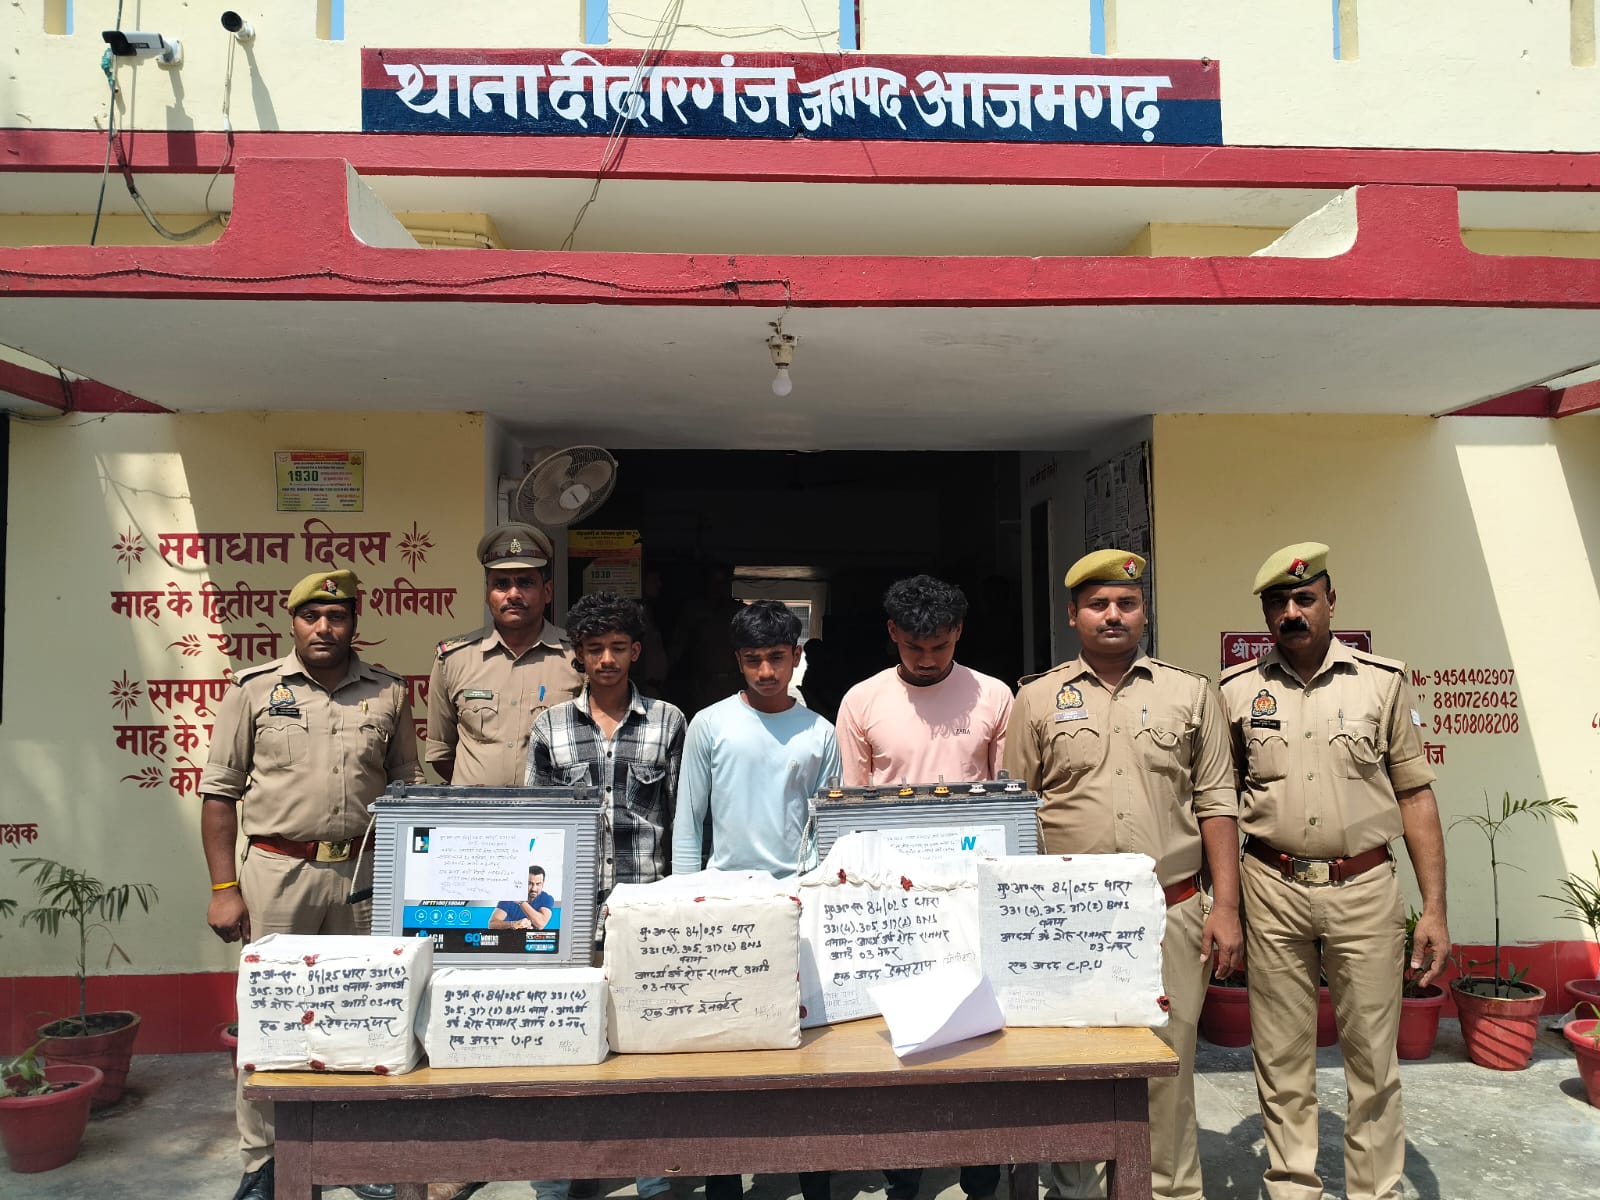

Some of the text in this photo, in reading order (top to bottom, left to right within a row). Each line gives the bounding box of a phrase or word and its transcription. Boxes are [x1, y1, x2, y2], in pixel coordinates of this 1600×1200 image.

[383, 50, 1172, 143] थाना दीदारगंज जनपद आजमगढ़
[288, 470, 319, 482] 1930
[158, 518, 391, 569] समाधान दिवस
[110, 591, 165, 626] माह
[167, 581, 192, 618] के
[199, 580, 277, 624] द्वितीय
[370, 577, 457, 619] शनिवार
[208, 623, 282, 661] थाने
[1231, 638, 1249, 660] श्री
[1433, 691, 1518, 709] 8810726042
[113, 725, 169, 763] माह
[173, 715, 199, 753] के
[1432, 713, 1519, 735] 9450808208
[464, 933, 480, 942] 60
